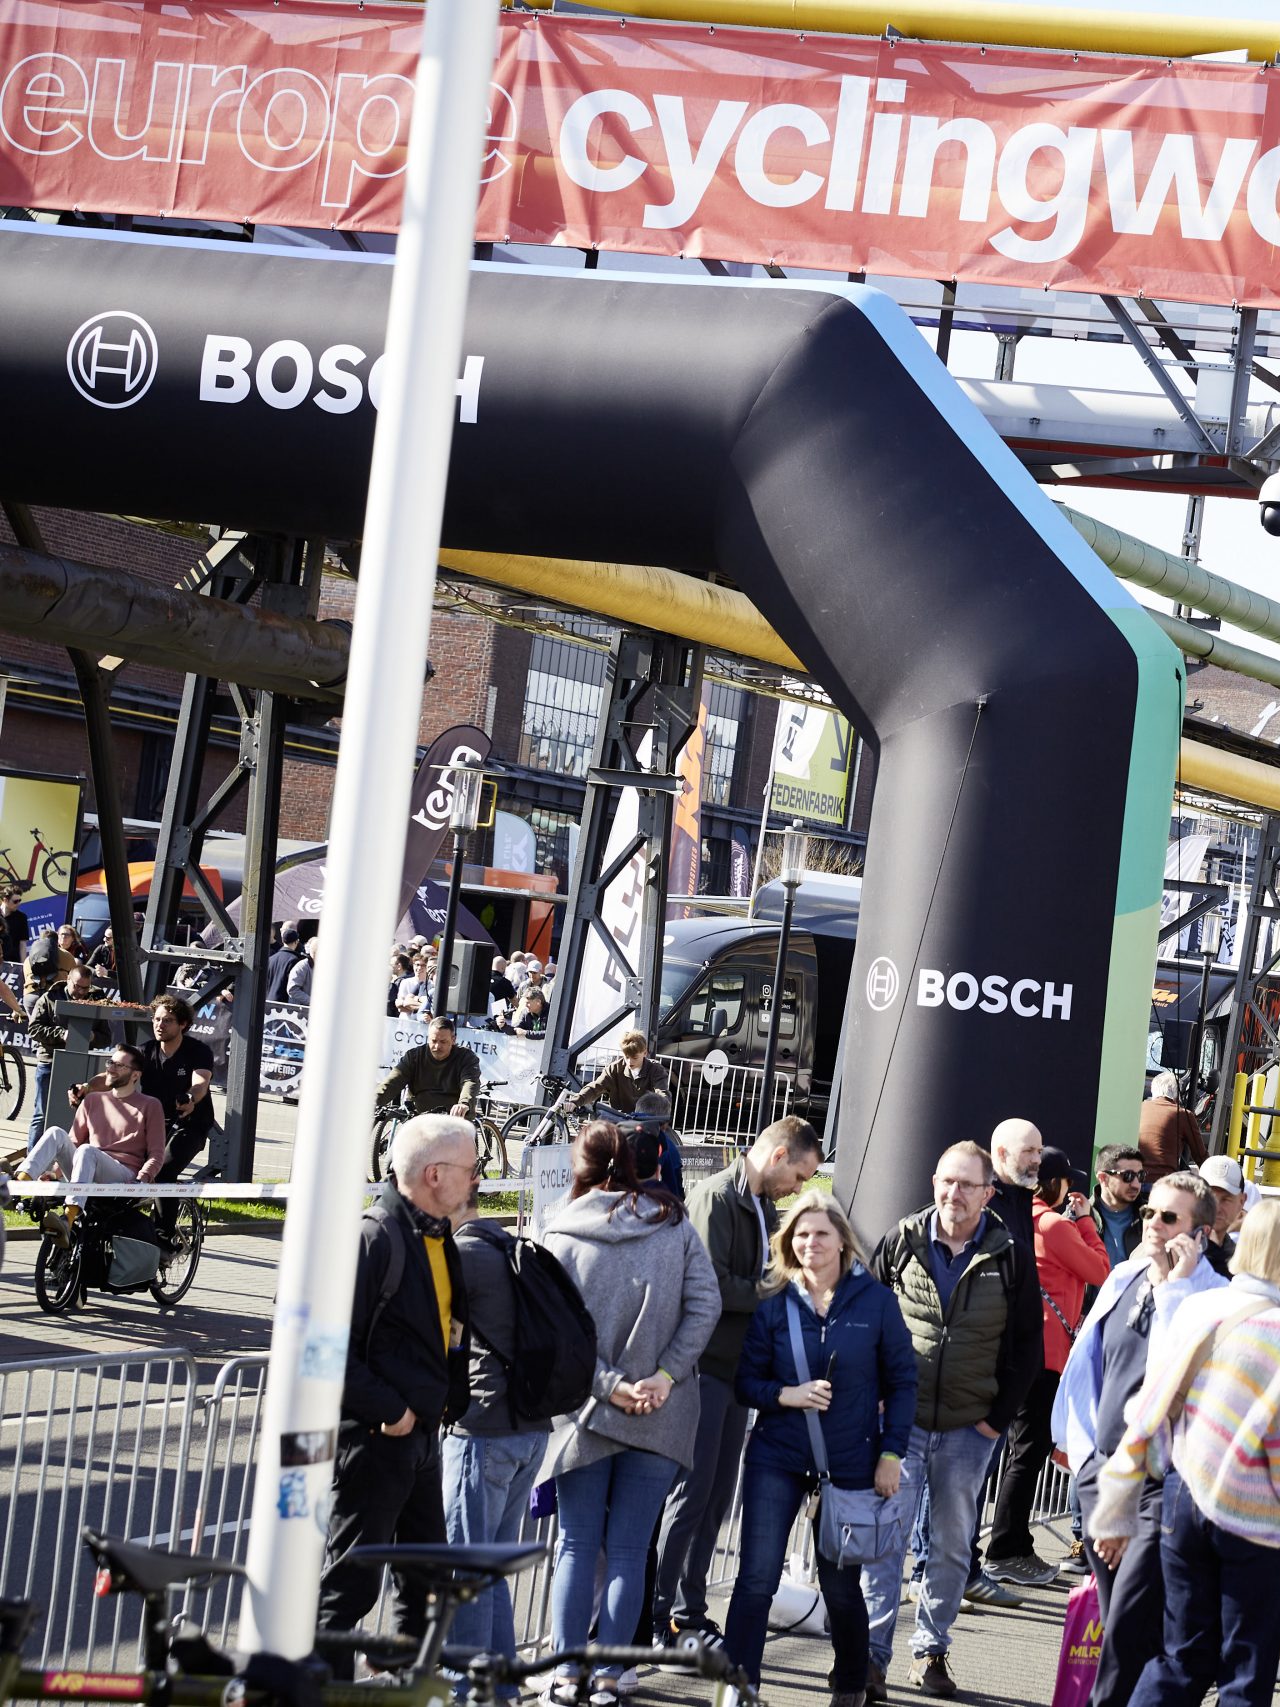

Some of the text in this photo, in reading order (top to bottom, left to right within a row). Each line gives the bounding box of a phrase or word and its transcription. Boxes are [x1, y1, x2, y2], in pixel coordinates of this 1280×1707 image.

[200, 334, 485, 424] BOSH
[771, 783, 844, 819] FEDERNFABRIK
[687, 846, 698, 898] NDUSTRIES
[916, 968, 1074, 1021] BOSCH
